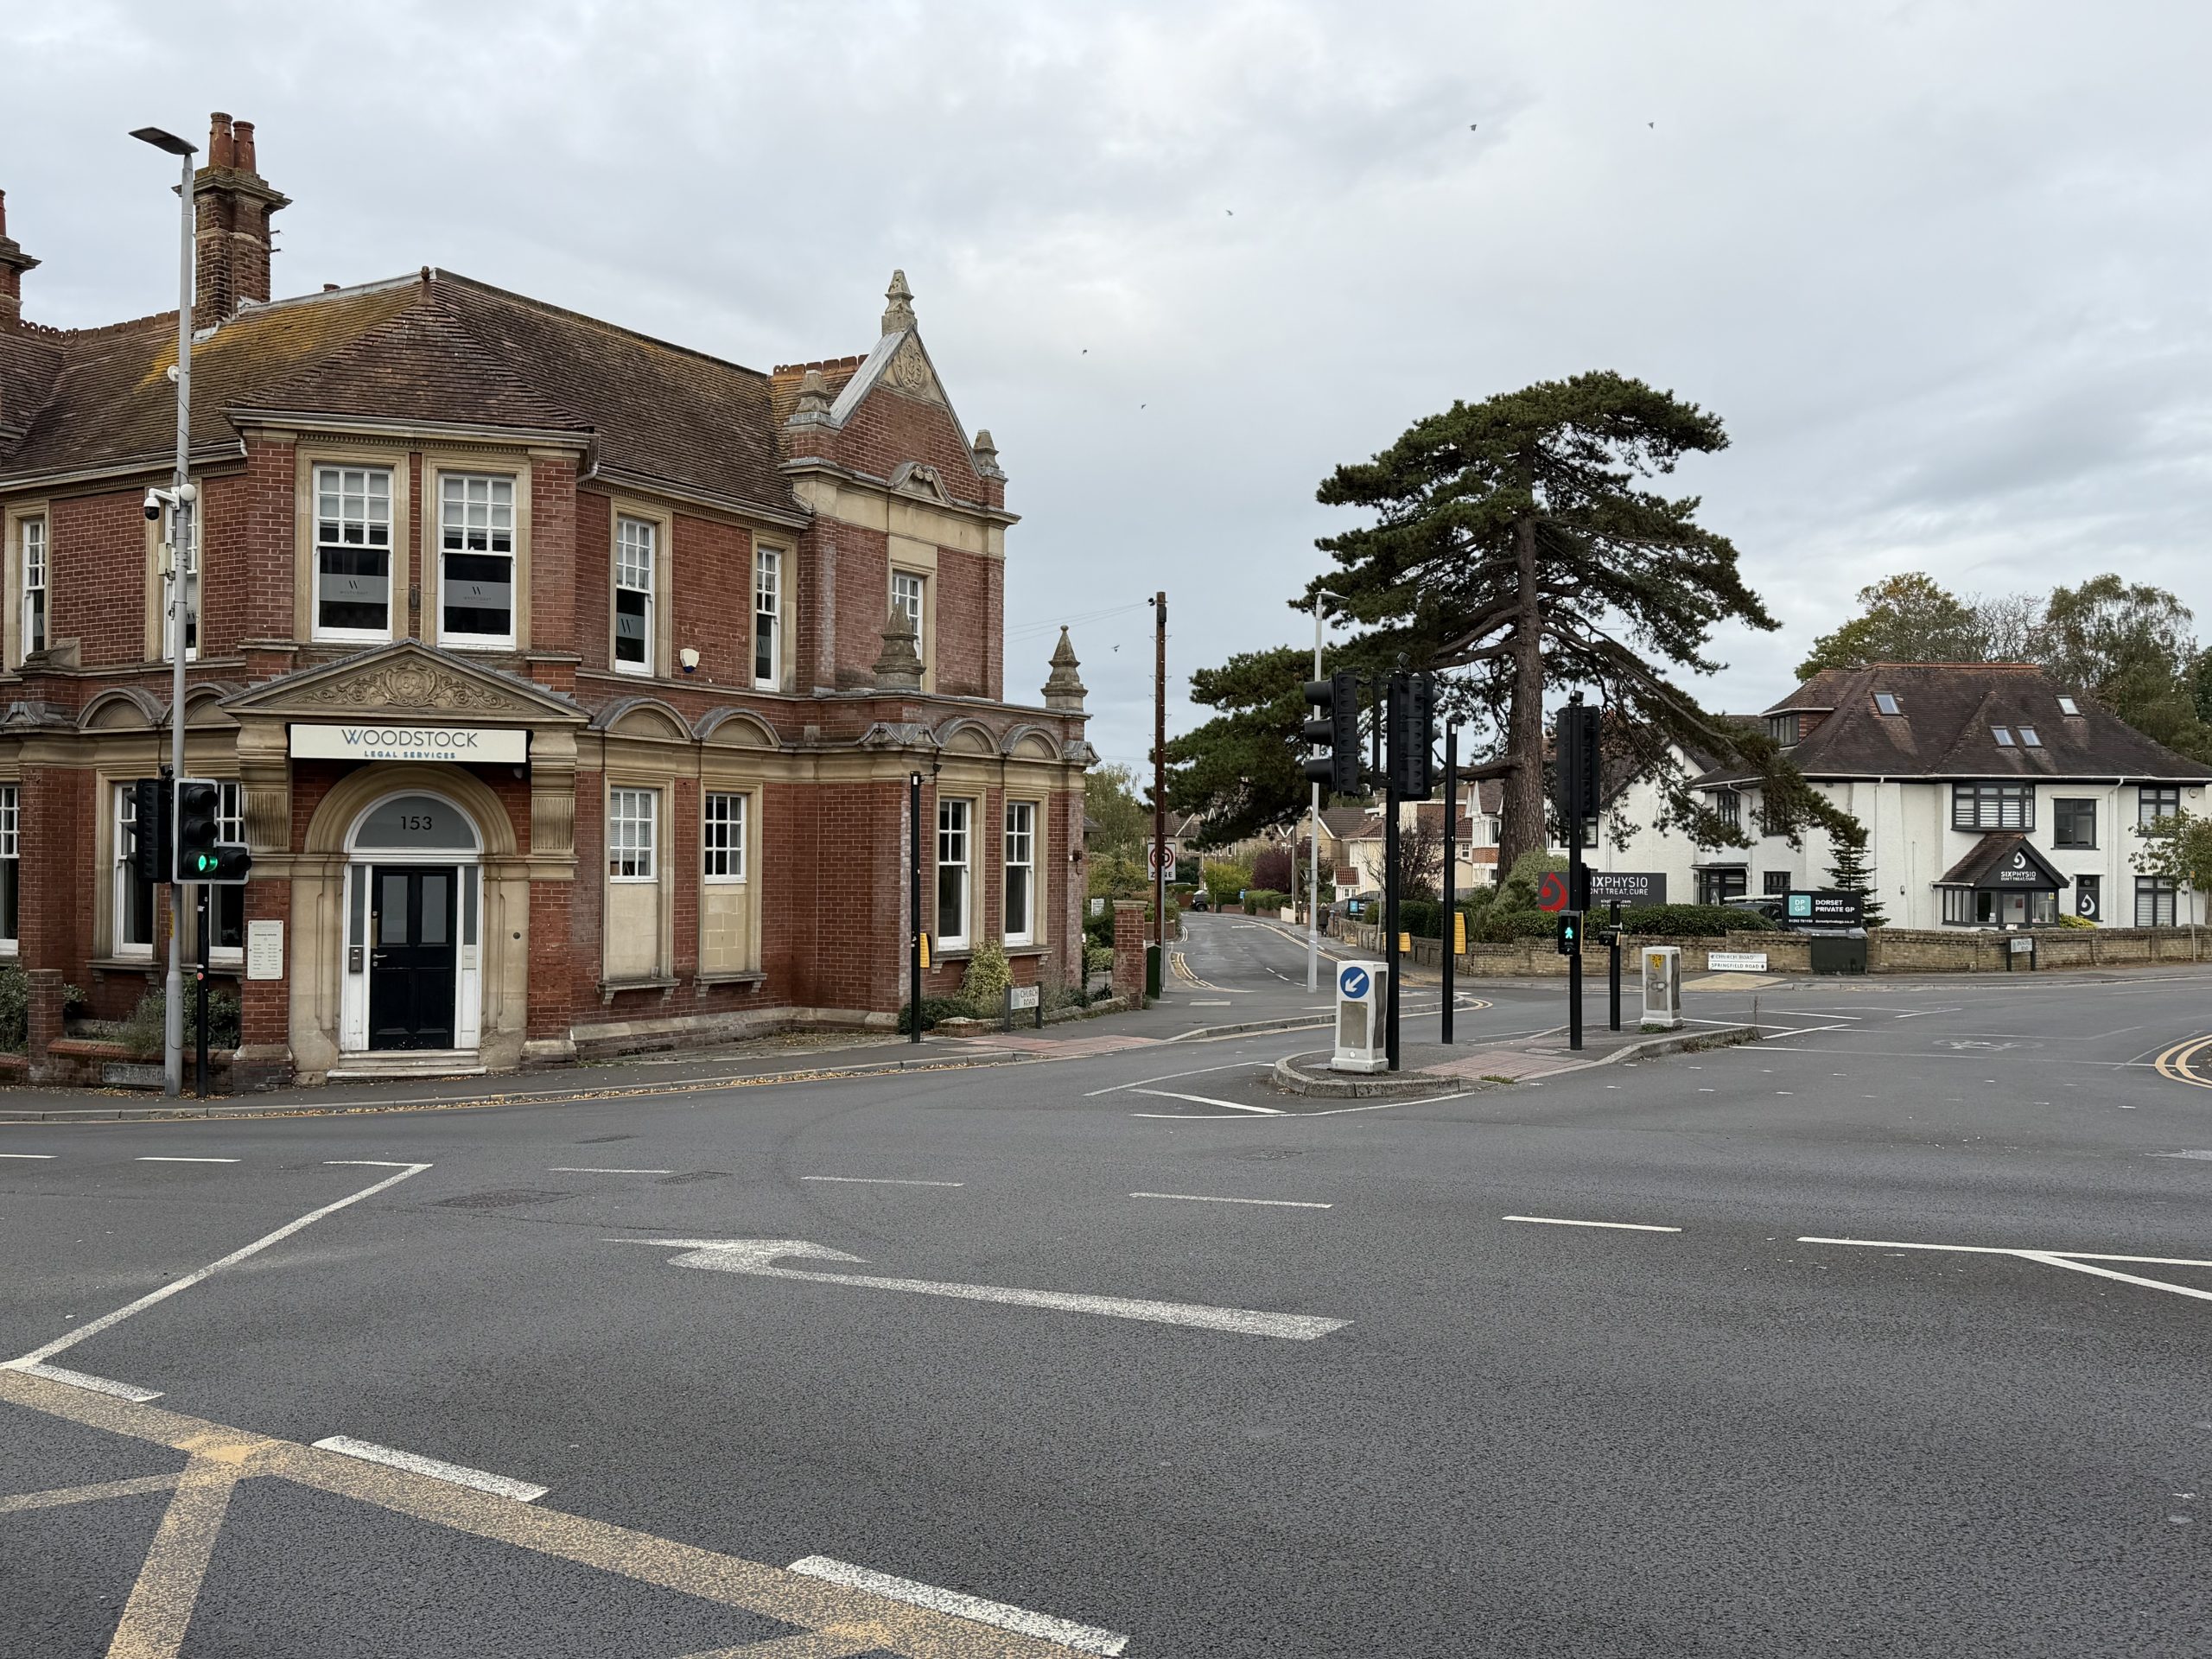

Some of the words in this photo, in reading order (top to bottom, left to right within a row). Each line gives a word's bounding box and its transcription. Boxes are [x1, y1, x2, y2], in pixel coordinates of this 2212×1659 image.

[341, 729, 478, 747] WOODSTOCK
[364, 750, 397, 759] LEGAL
[404, 751, 456, 760] SERVICES
[400, 816, 433, 830] 153
[1590, 876, 1648, 887] IXPHYSIO
[151, 1071, 165, 1082] ROA
